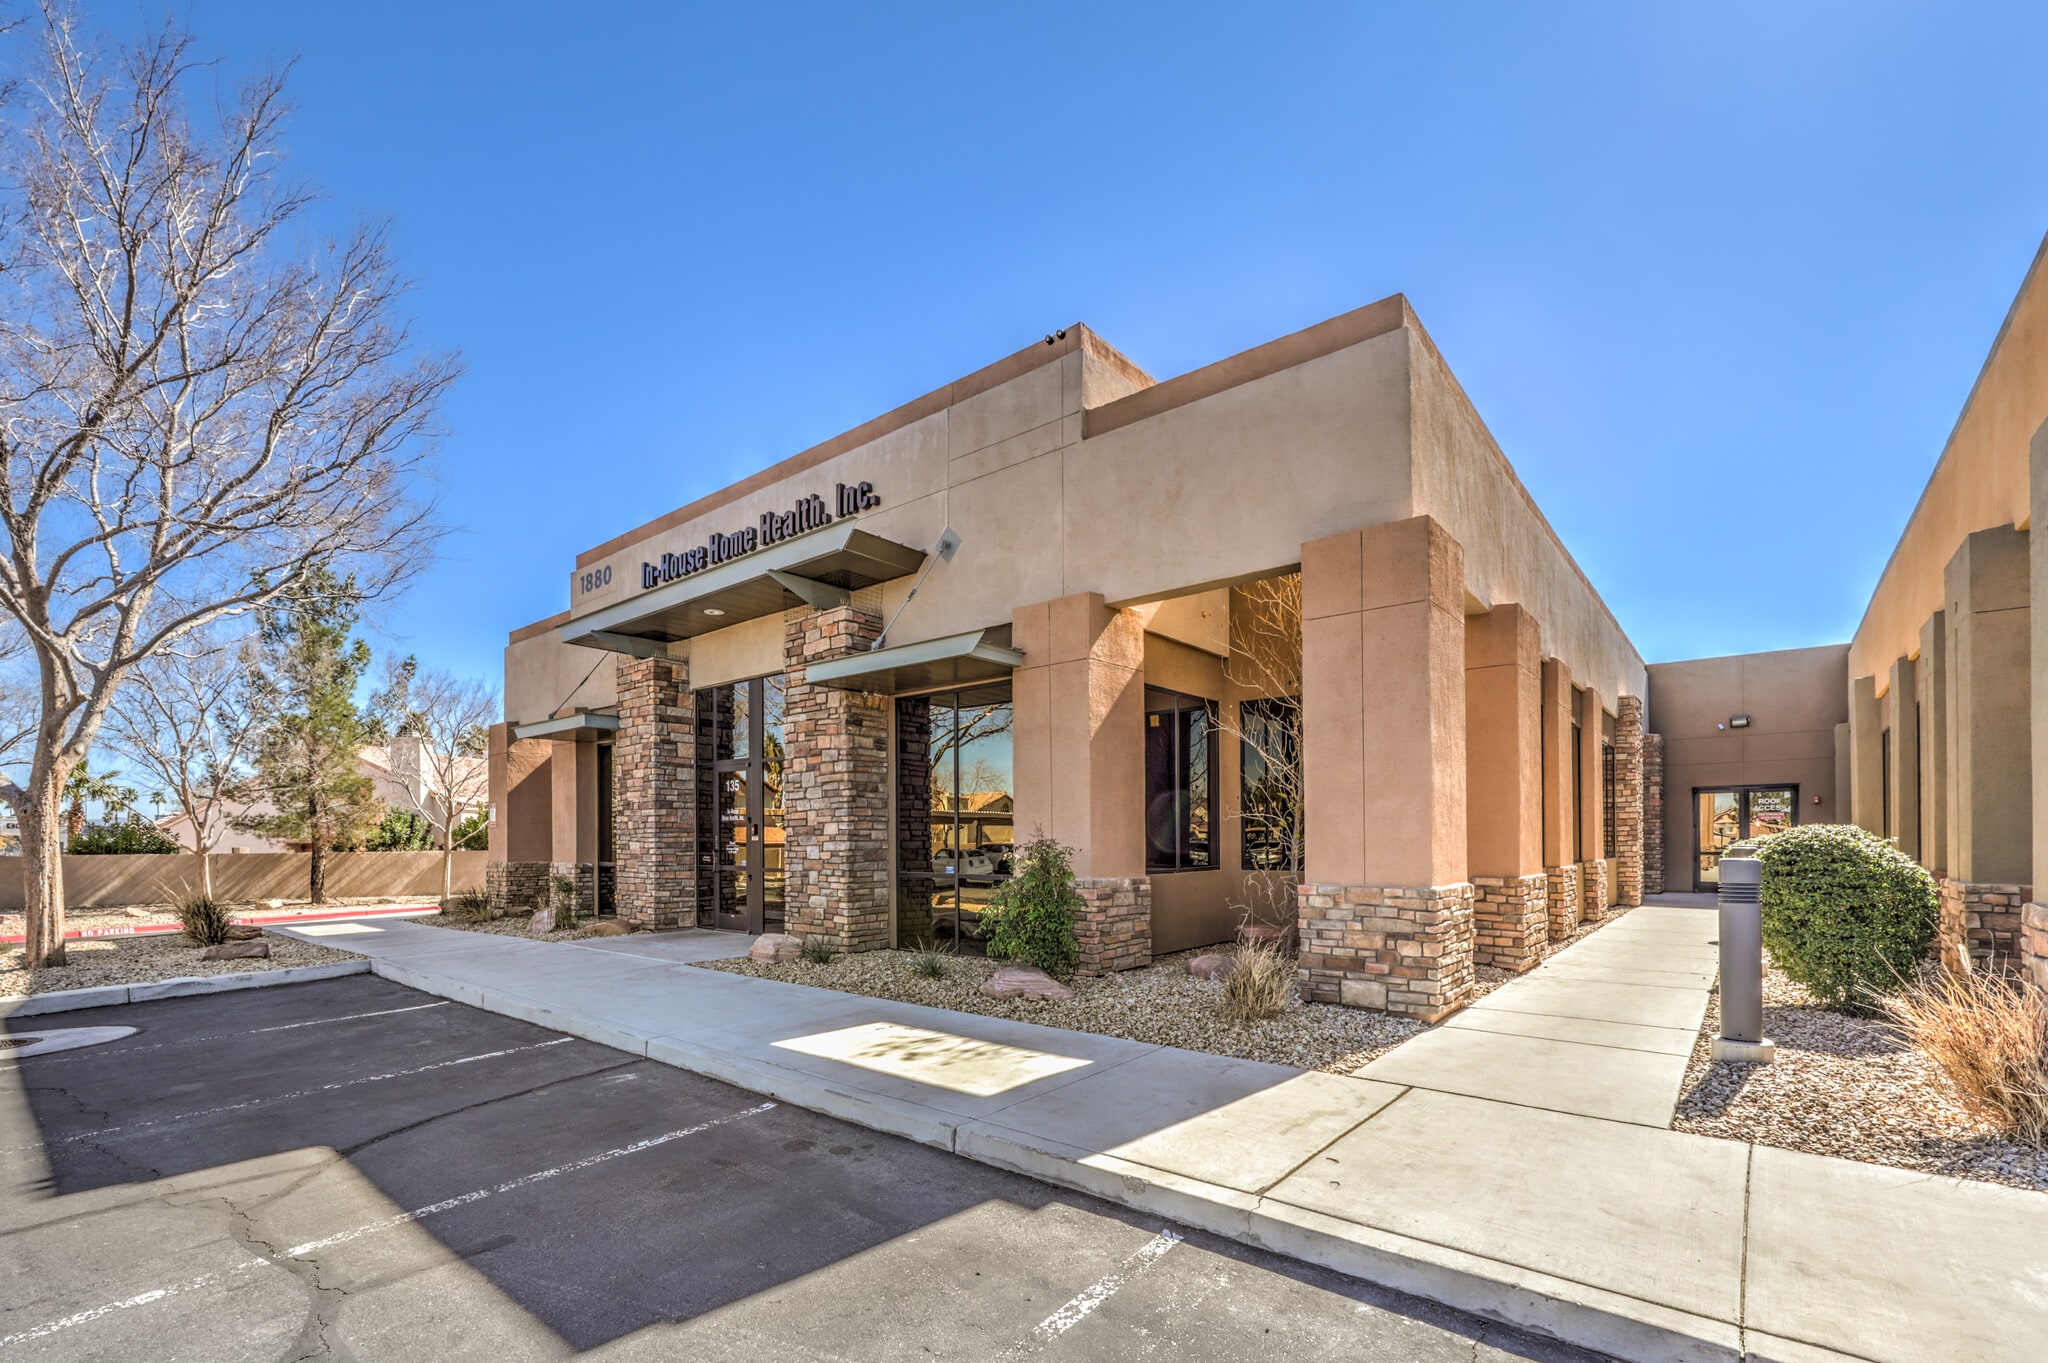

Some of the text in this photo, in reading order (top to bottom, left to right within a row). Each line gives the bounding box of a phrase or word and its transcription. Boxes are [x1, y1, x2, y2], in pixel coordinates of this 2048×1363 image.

[641, 545, 708, 589] In-House
[709, 527, 758, 565] Home
[835, 481, 881, 517] Inc.
[580, 565, 613, 595] 1880
[726, 780, 740, 791] 135
[81, 927, 136, 938] NO PARKING
